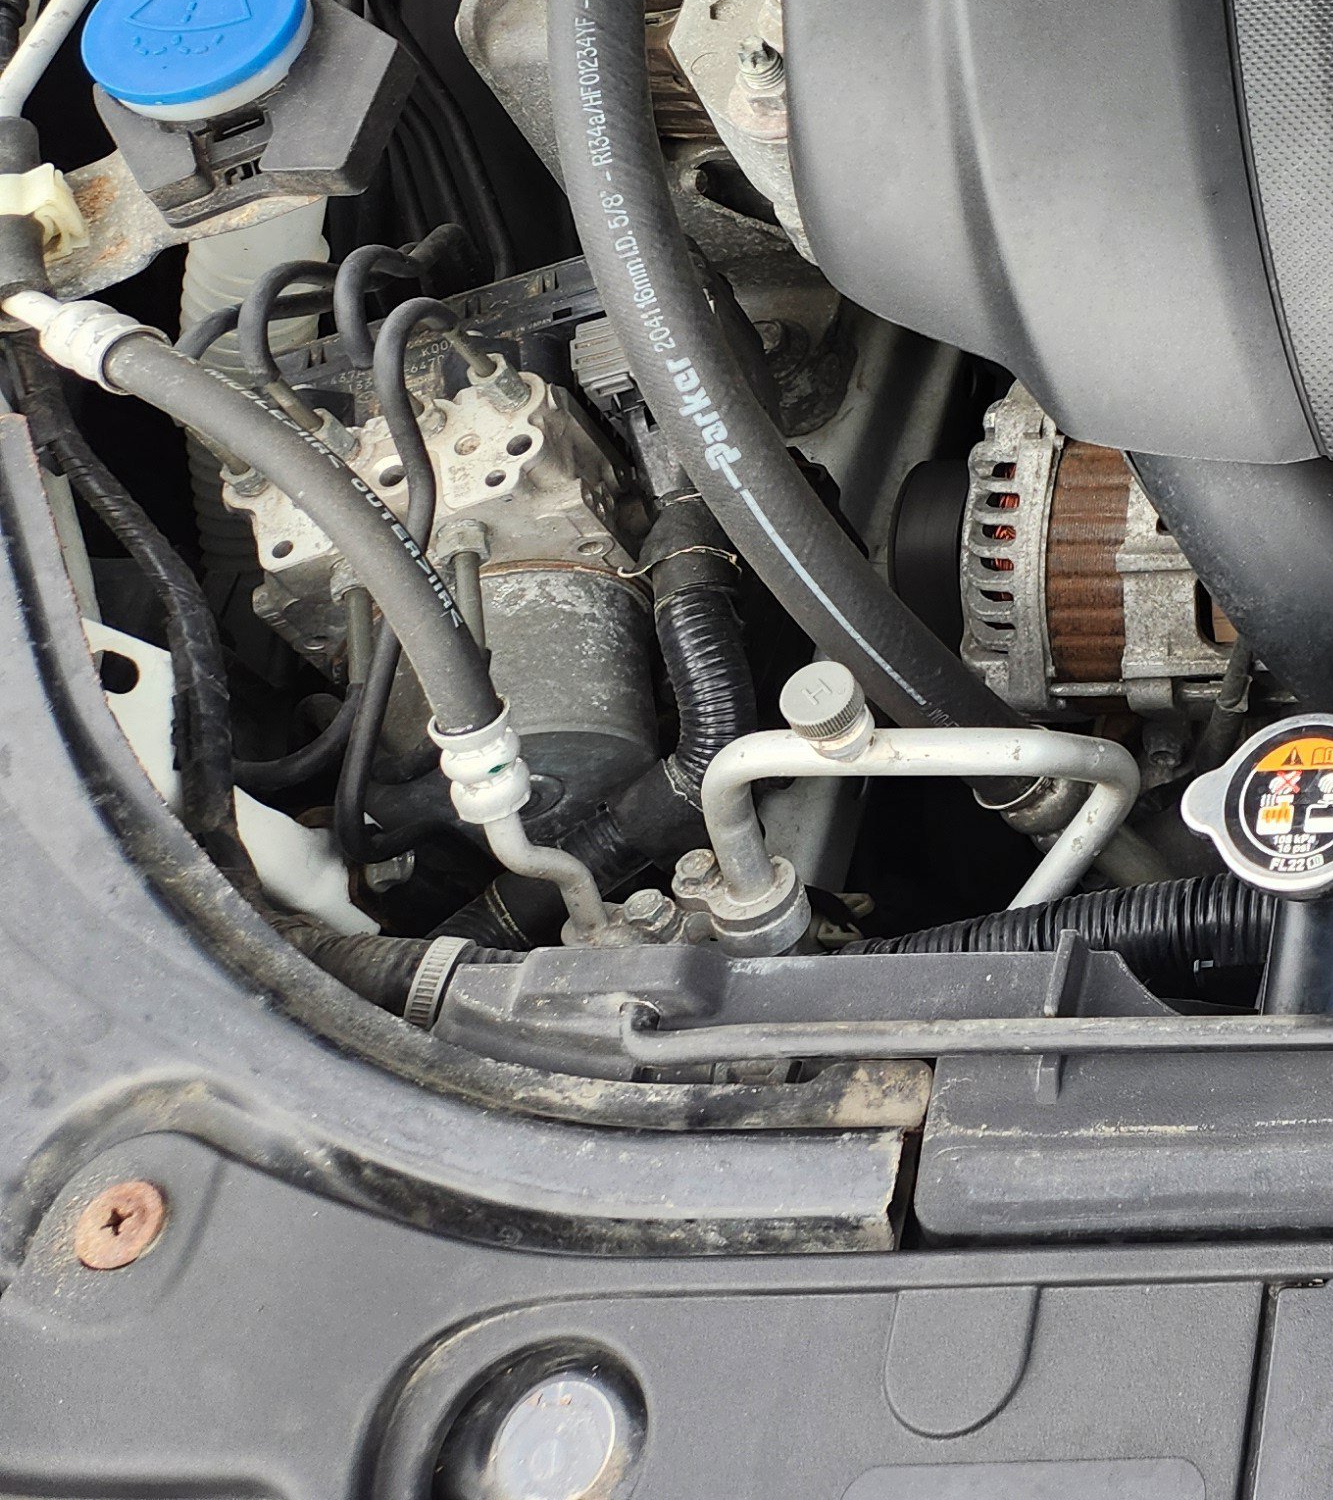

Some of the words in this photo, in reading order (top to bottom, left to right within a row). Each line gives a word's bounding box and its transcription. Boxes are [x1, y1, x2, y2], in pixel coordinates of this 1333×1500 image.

[640, 306, 675, 353] 2041
[664, 355, 741, 471] Parker
[1269, 857, 1305, 872] FL22
